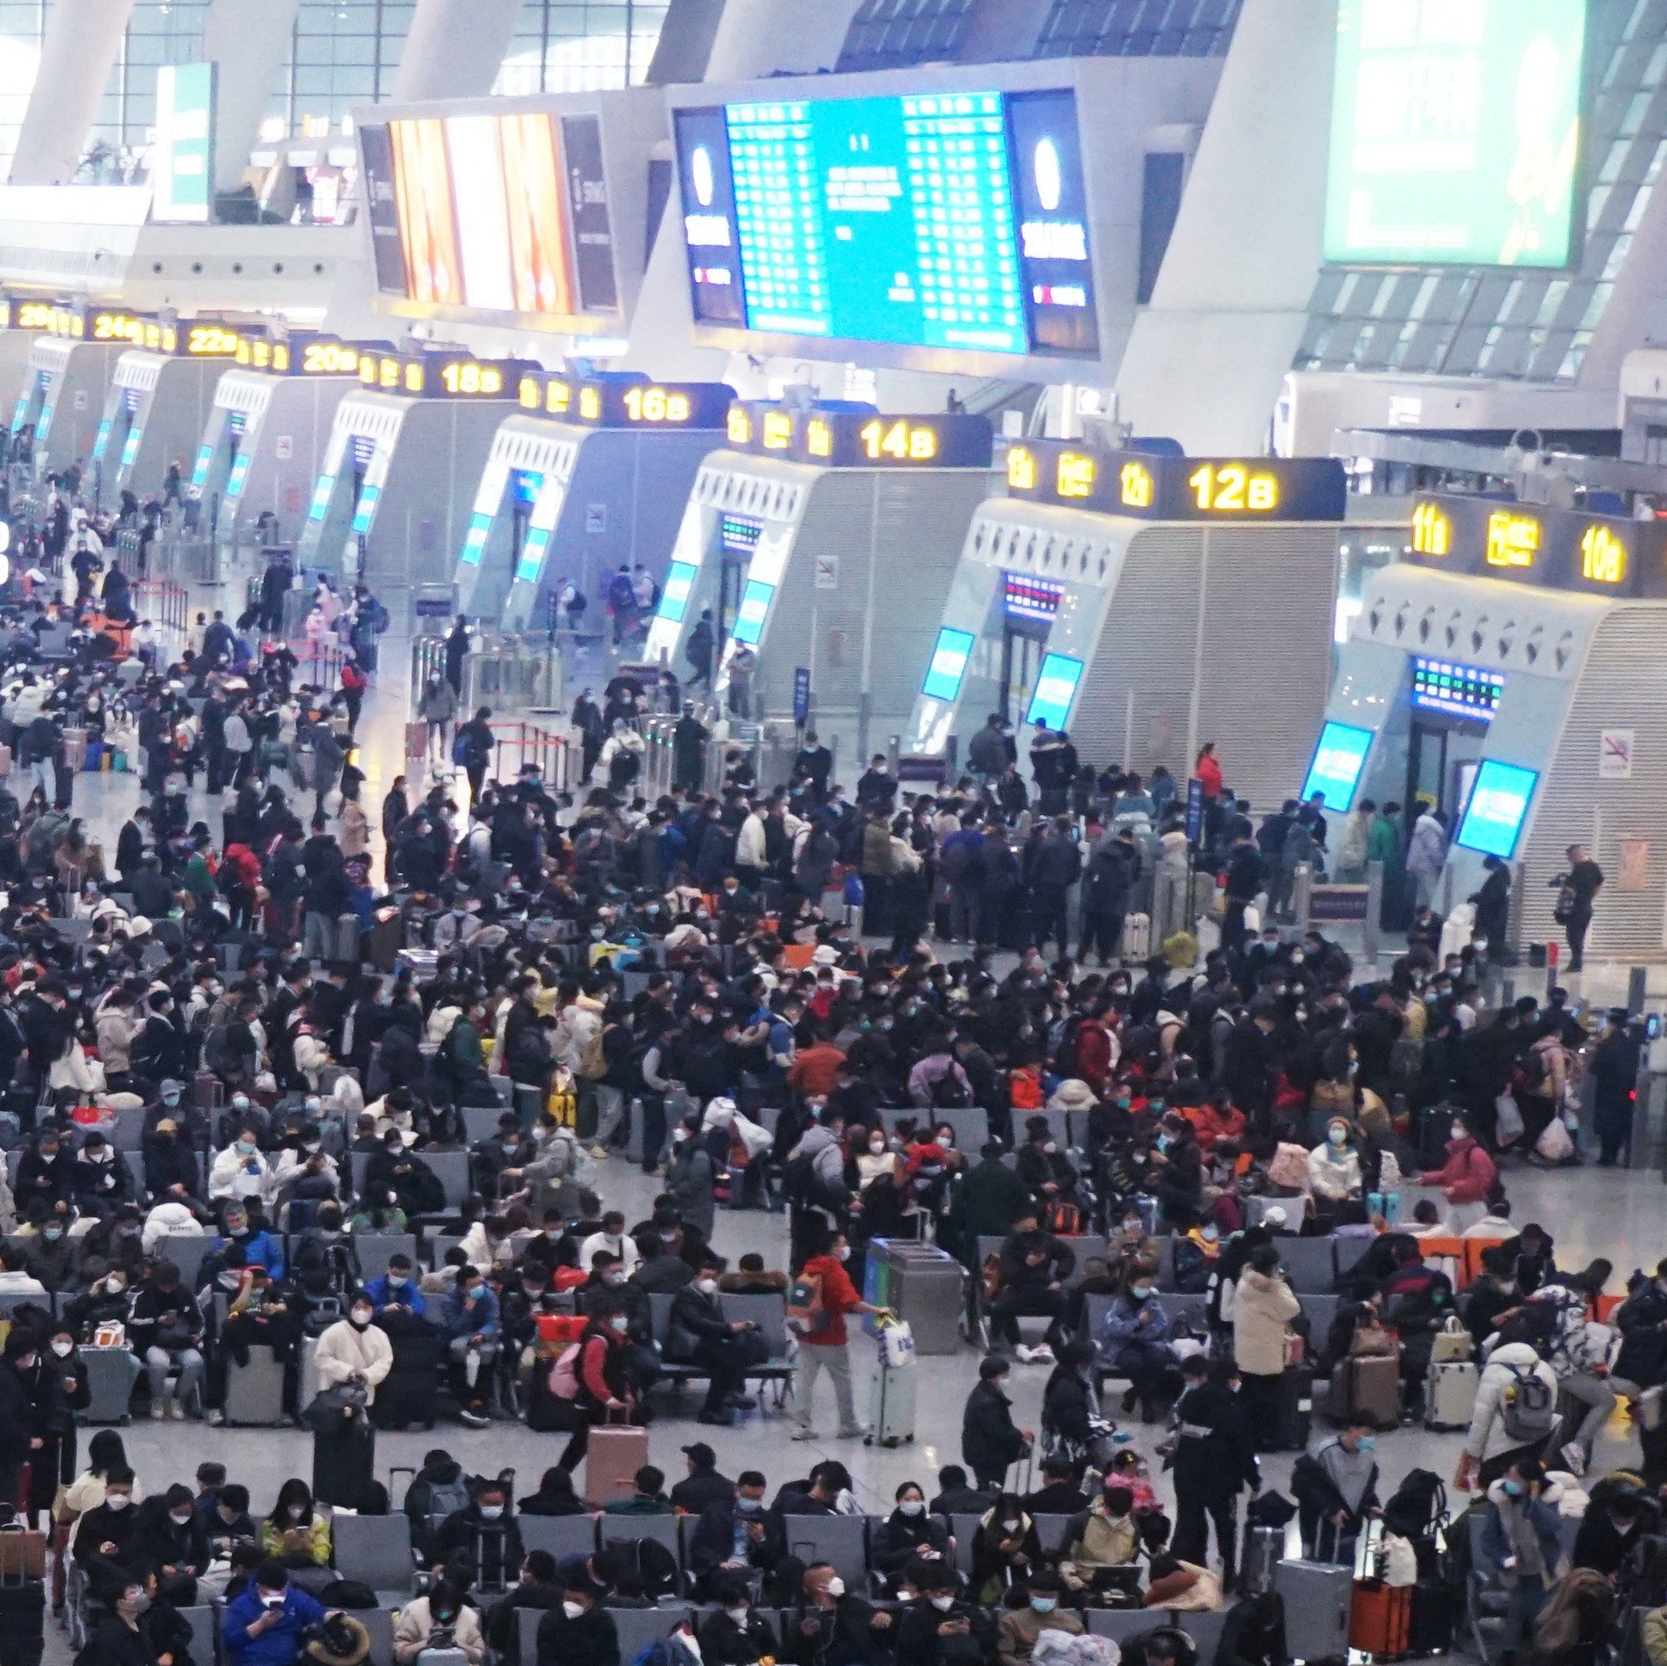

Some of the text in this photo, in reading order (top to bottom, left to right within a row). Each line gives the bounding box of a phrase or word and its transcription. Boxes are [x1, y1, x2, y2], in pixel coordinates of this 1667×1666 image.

[442, 363, 503, 393] 18B
[623, 387, 691, 421] 16B
[860, 419, 938, 459] 14B
[1189, 463, 1280, 511] 12B
